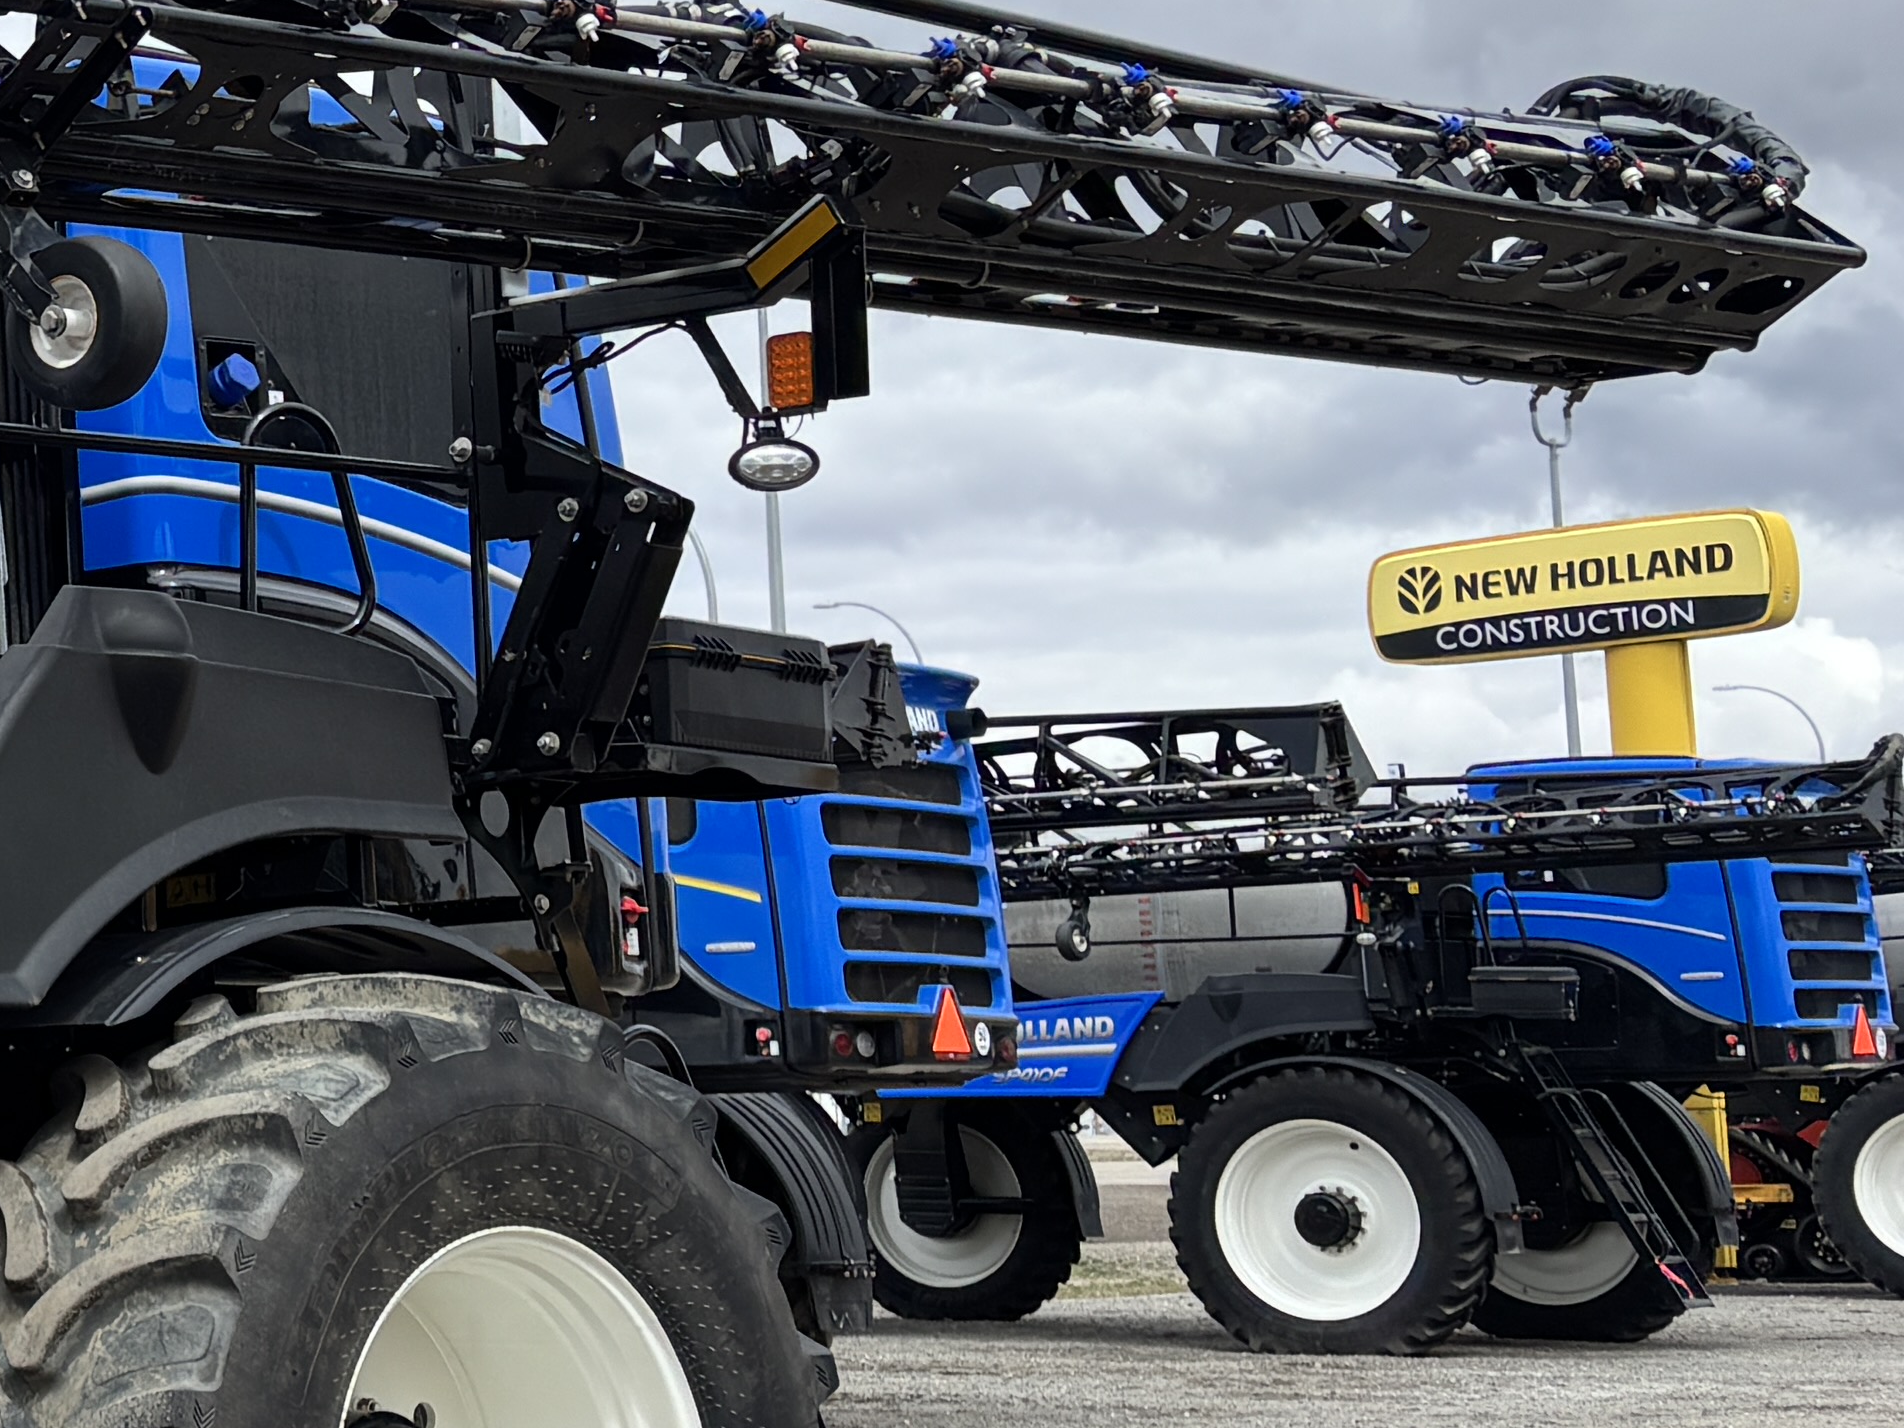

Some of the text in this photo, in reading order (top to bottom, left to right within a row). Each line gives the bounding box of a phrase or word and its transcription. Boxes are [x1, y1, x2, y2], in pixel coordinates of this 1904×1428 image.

[1454, 542, 1733, 603] NEW HOLLAND
[1436, 599, 1695, 651] CONSTRUCTION
[1016, 1016, 1114, 1042] LLAND
